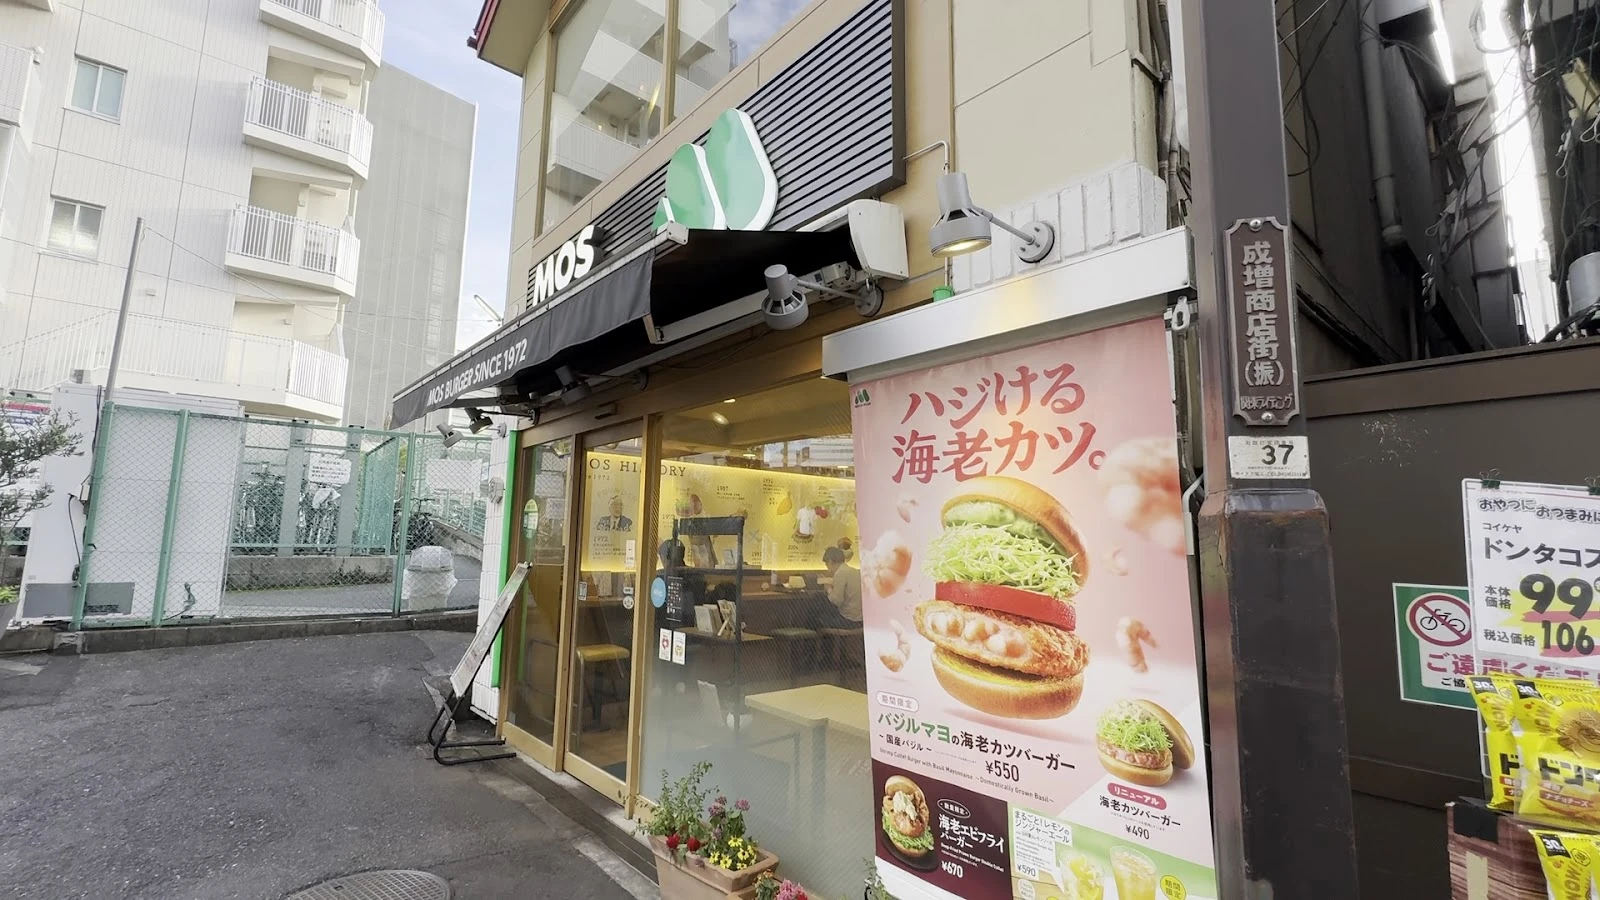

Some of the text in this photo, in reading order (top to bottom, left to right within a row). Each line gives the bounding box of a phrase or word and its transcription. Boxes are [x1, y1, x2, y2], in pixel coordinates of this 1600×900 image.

[532, 225, 595, 307] MOS
[427, 338, 528, 407] MOS BURGER SINCE 1972
[900, 363, 1086, 429] ハジける
[891, 420, 1107, 484] 海老カツ。
[1261, 444, 1295, 465] 37
[1479, 498, 1536, 511] おやつに
[1482, 522, 1522, 534] コイケヤ
[1484, 537, 1600, 569] ドンタコス
[1484, 584, 1511, 597] 本体
[1519, 573, 1594, 620] 99
[1484, 596, 1512, 610] 価格
[1483, 629, 1536, 647] 税込価格
[1541, 620, 1595, 655] 106
[878, 713, 1076, 771] バジルマヨの海老カツバーガー
[932, 762, 945, 771] Basil
[1014, 787, 1033, 798] Grown
[985, 760, 1020, 782] ¥550
[1113, 786, 1160, 806] リニューアル
[1099, 795, 1181, 826] 海老カツバーガー
[938, 813, 1005, 853] 海老エビフライ
[940, 831, 974, 848] バーガー
[1125, 824, 1150, 840] ¥490
[941, 860, 964, 878] ¥670
[1017, 863, 1037, 877] ¥590
